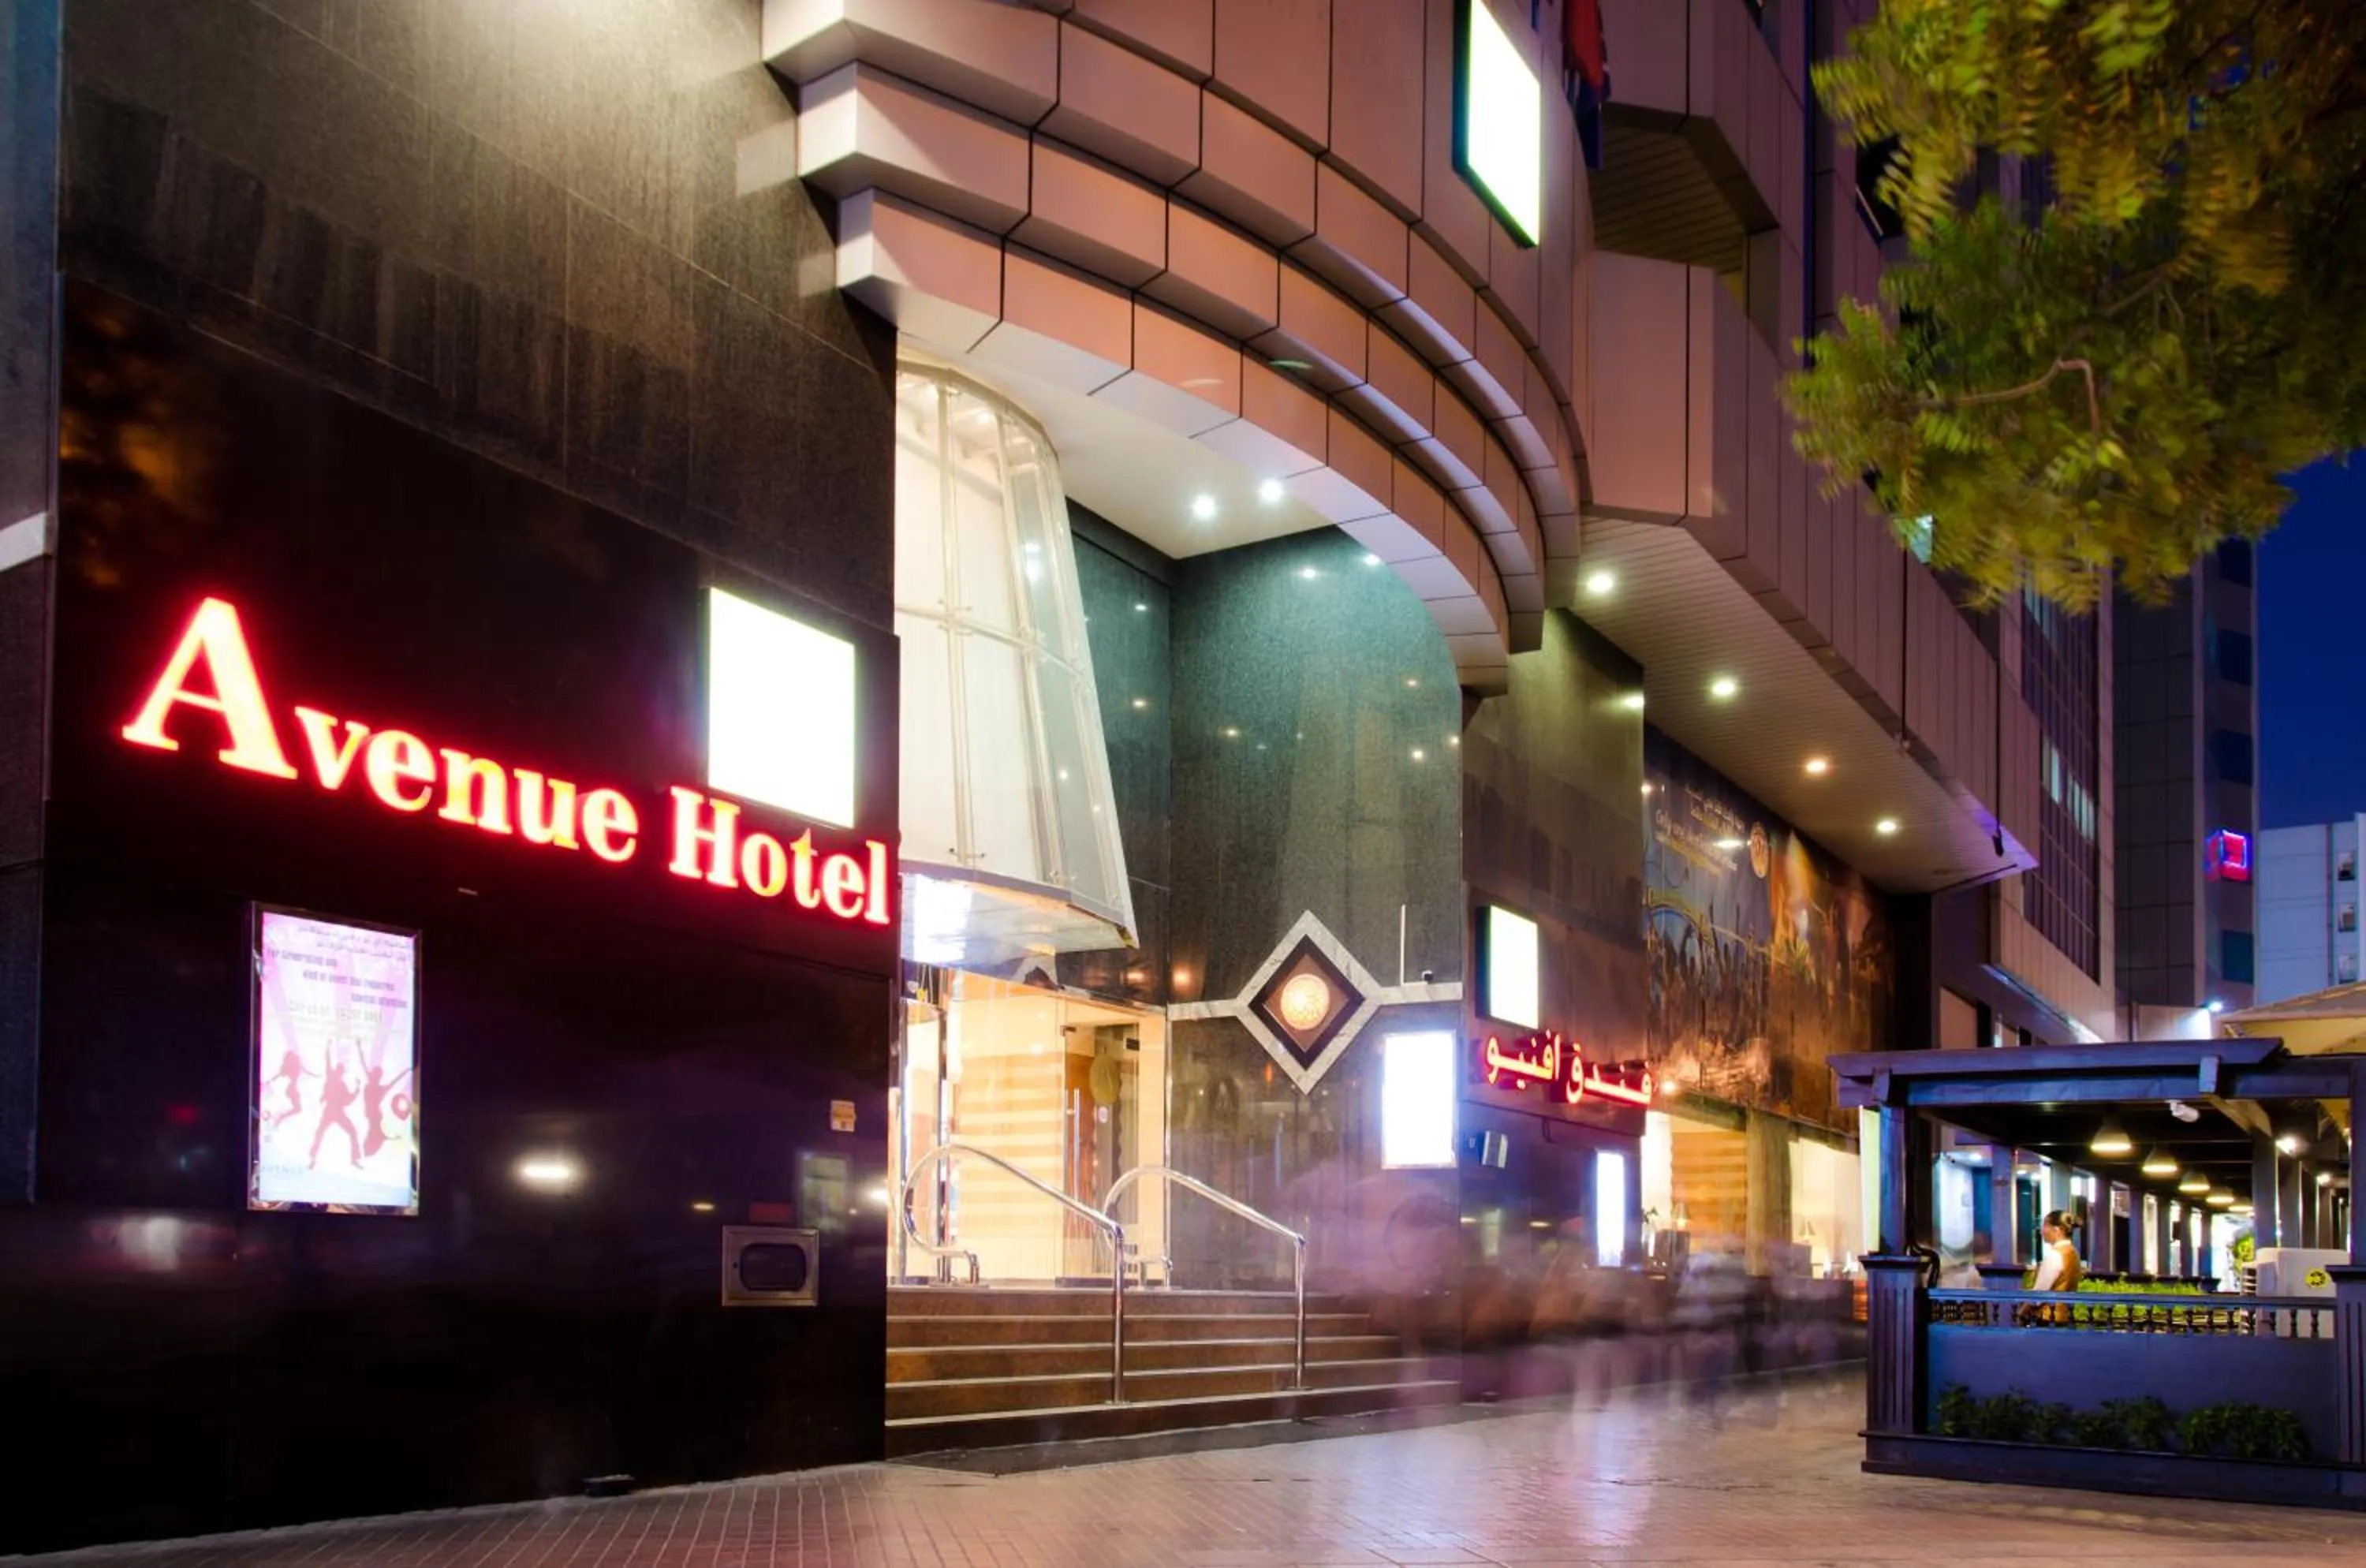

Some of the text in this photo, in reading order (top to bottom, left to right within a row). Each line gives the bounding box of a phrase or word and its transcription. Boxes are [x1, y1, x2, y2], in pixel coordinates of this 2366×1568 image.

[121, 597, 890, 925] Avenue Hotel
[1566, 1042, 1651, 1105] فندق
